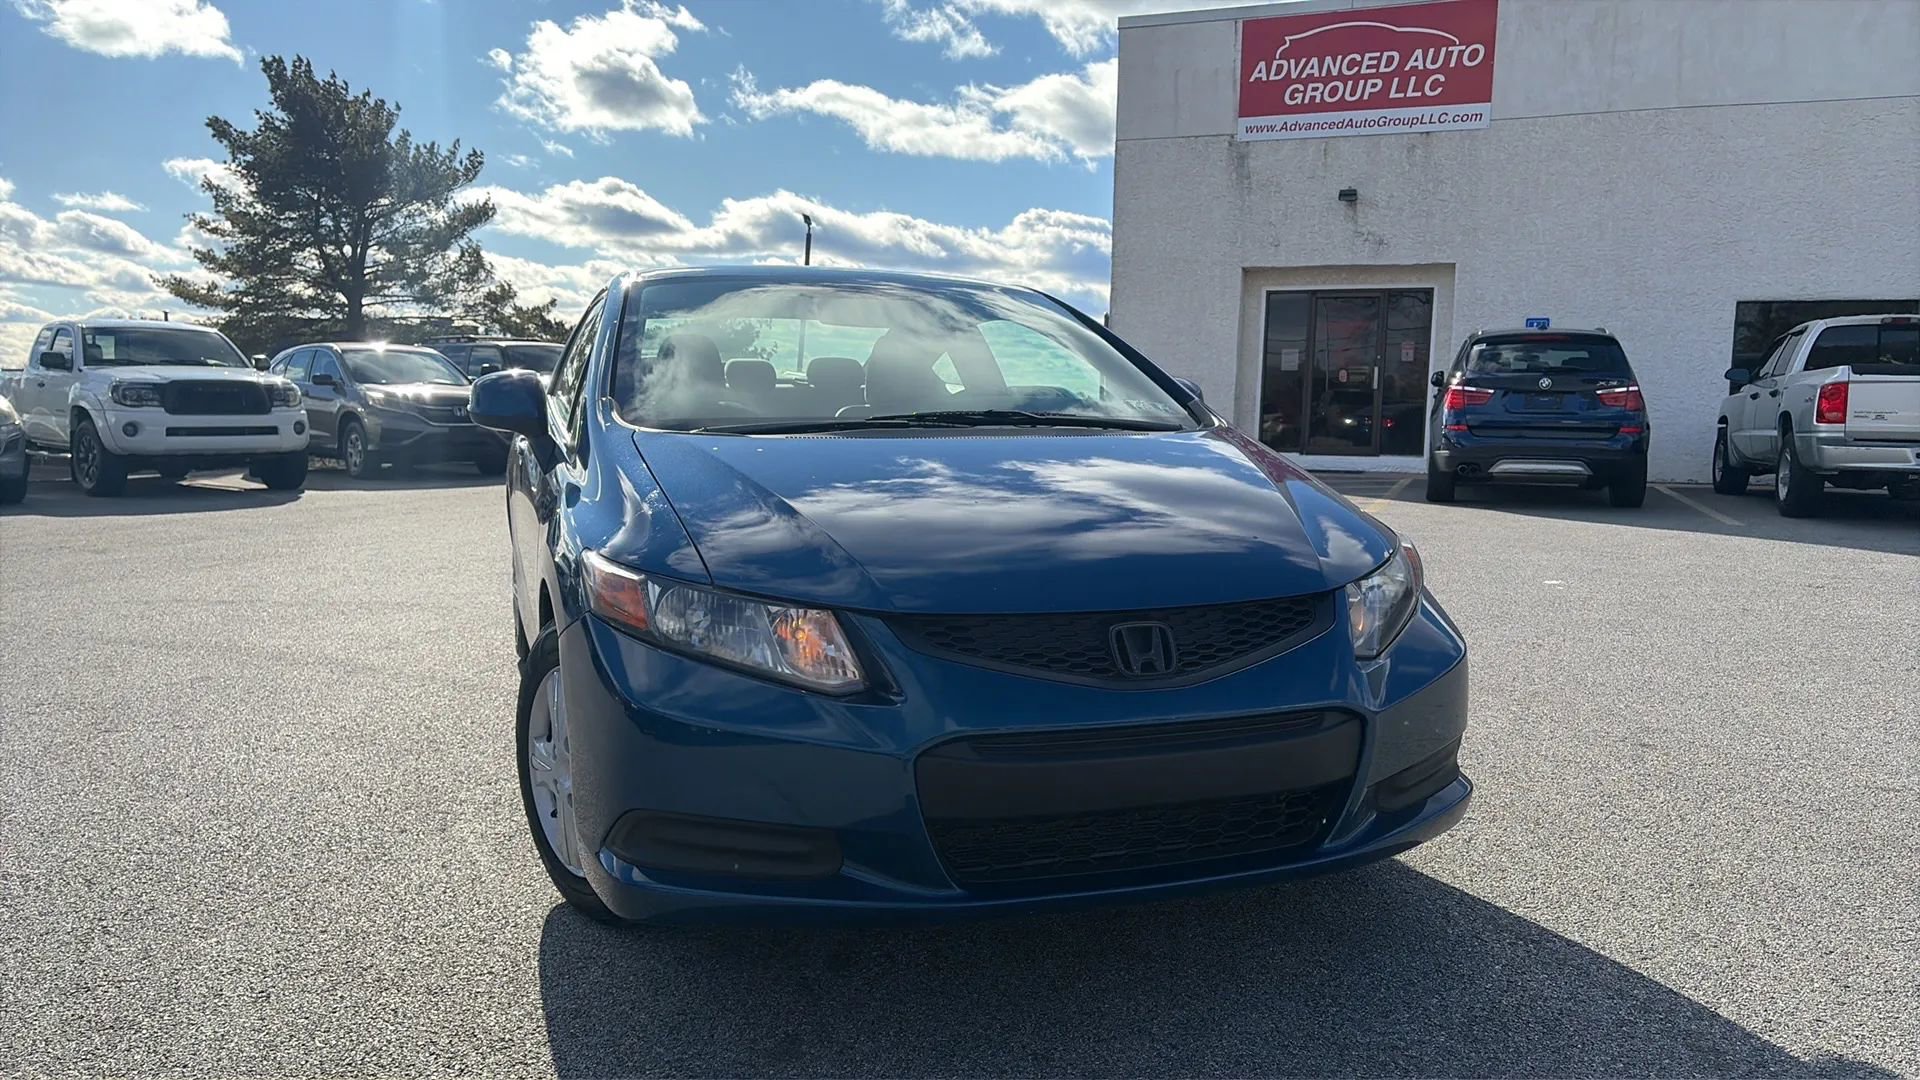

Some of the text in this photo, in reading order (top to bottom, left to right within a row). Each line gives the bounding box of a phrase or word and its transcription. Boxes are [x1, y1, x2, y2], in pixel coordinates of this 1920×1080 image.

[1249, 43, 1485, 82] ADVANCED AUTO
[1284, 75, 1445, 105] GROUP LLC
[1244, 111, 1483, 134] www.AdvancedAutoGroupLLC.com
